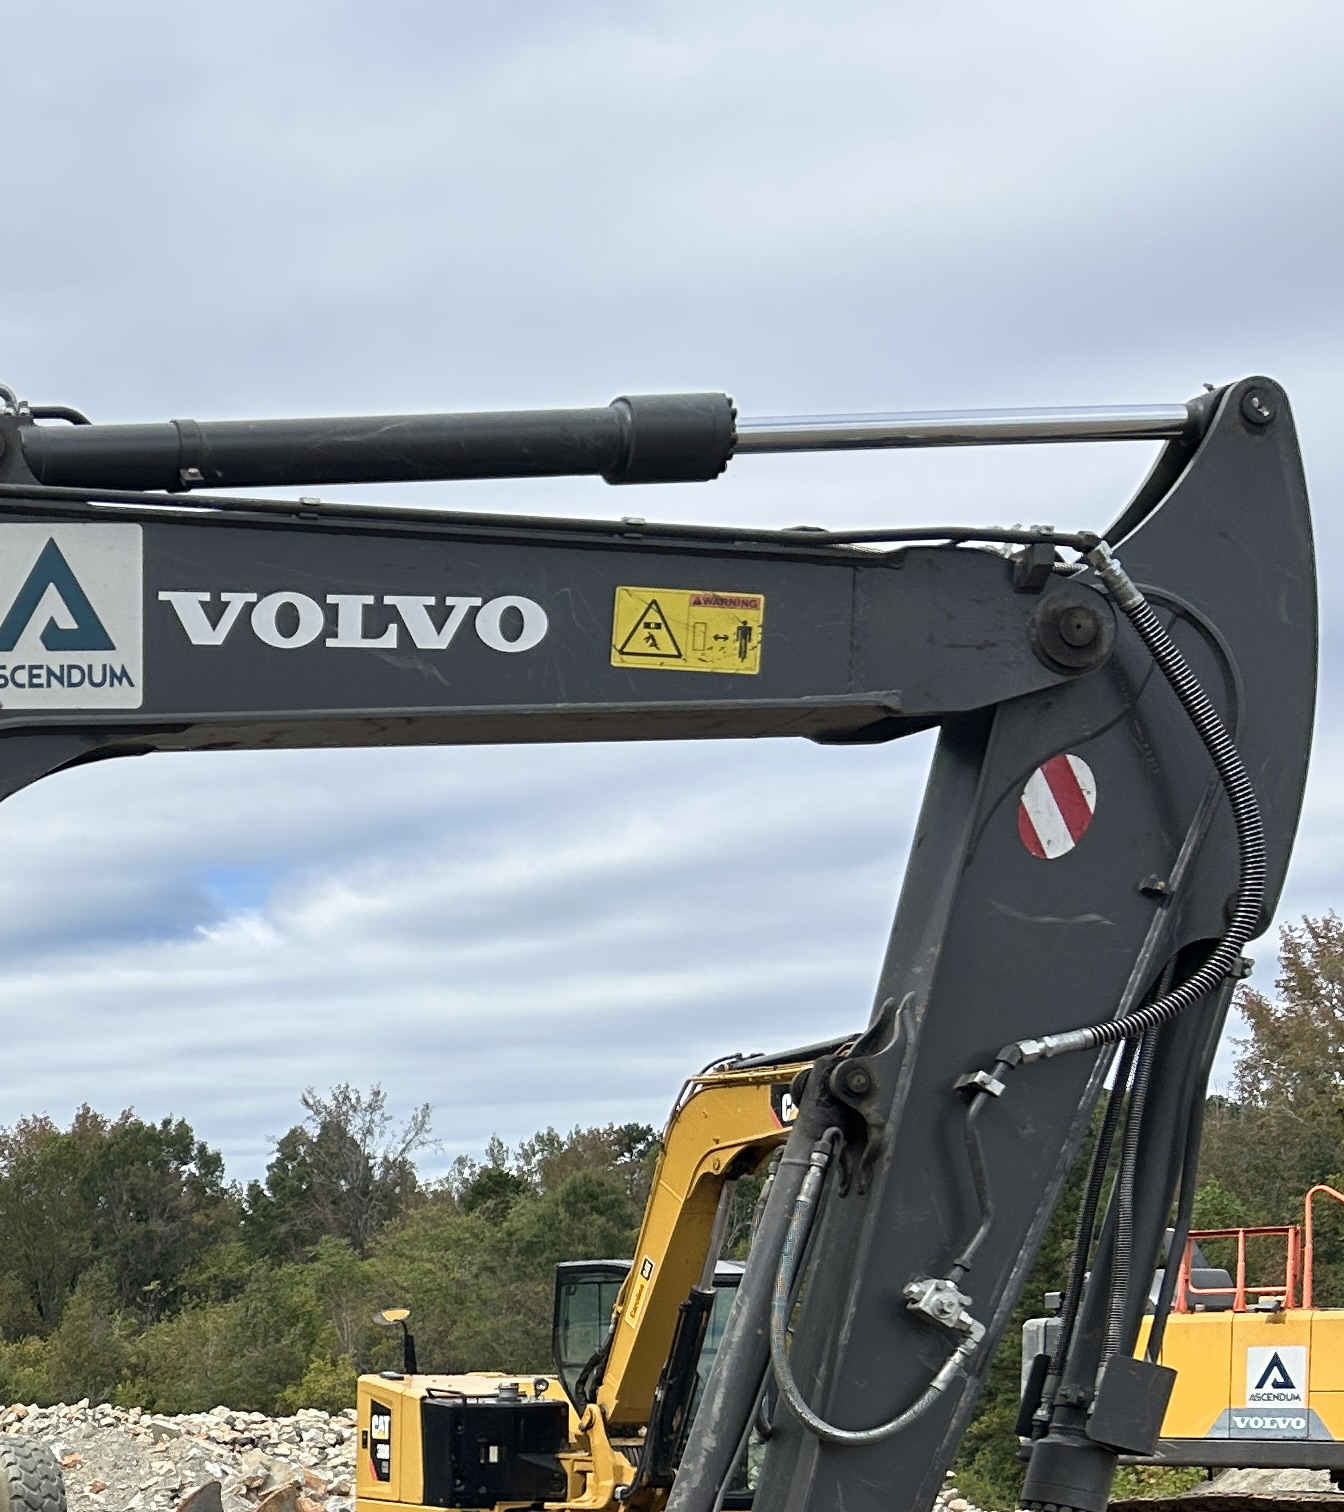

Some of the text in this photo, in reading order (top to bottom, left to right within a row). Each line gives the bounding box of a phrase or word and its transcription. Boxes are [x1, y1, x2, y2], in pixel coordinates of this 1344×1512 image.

[702, 597, 758, 609] WARNING
[158, 591, 548, 653] VOLVO
[1233, 1416, 1306, 1430] VOLVO
